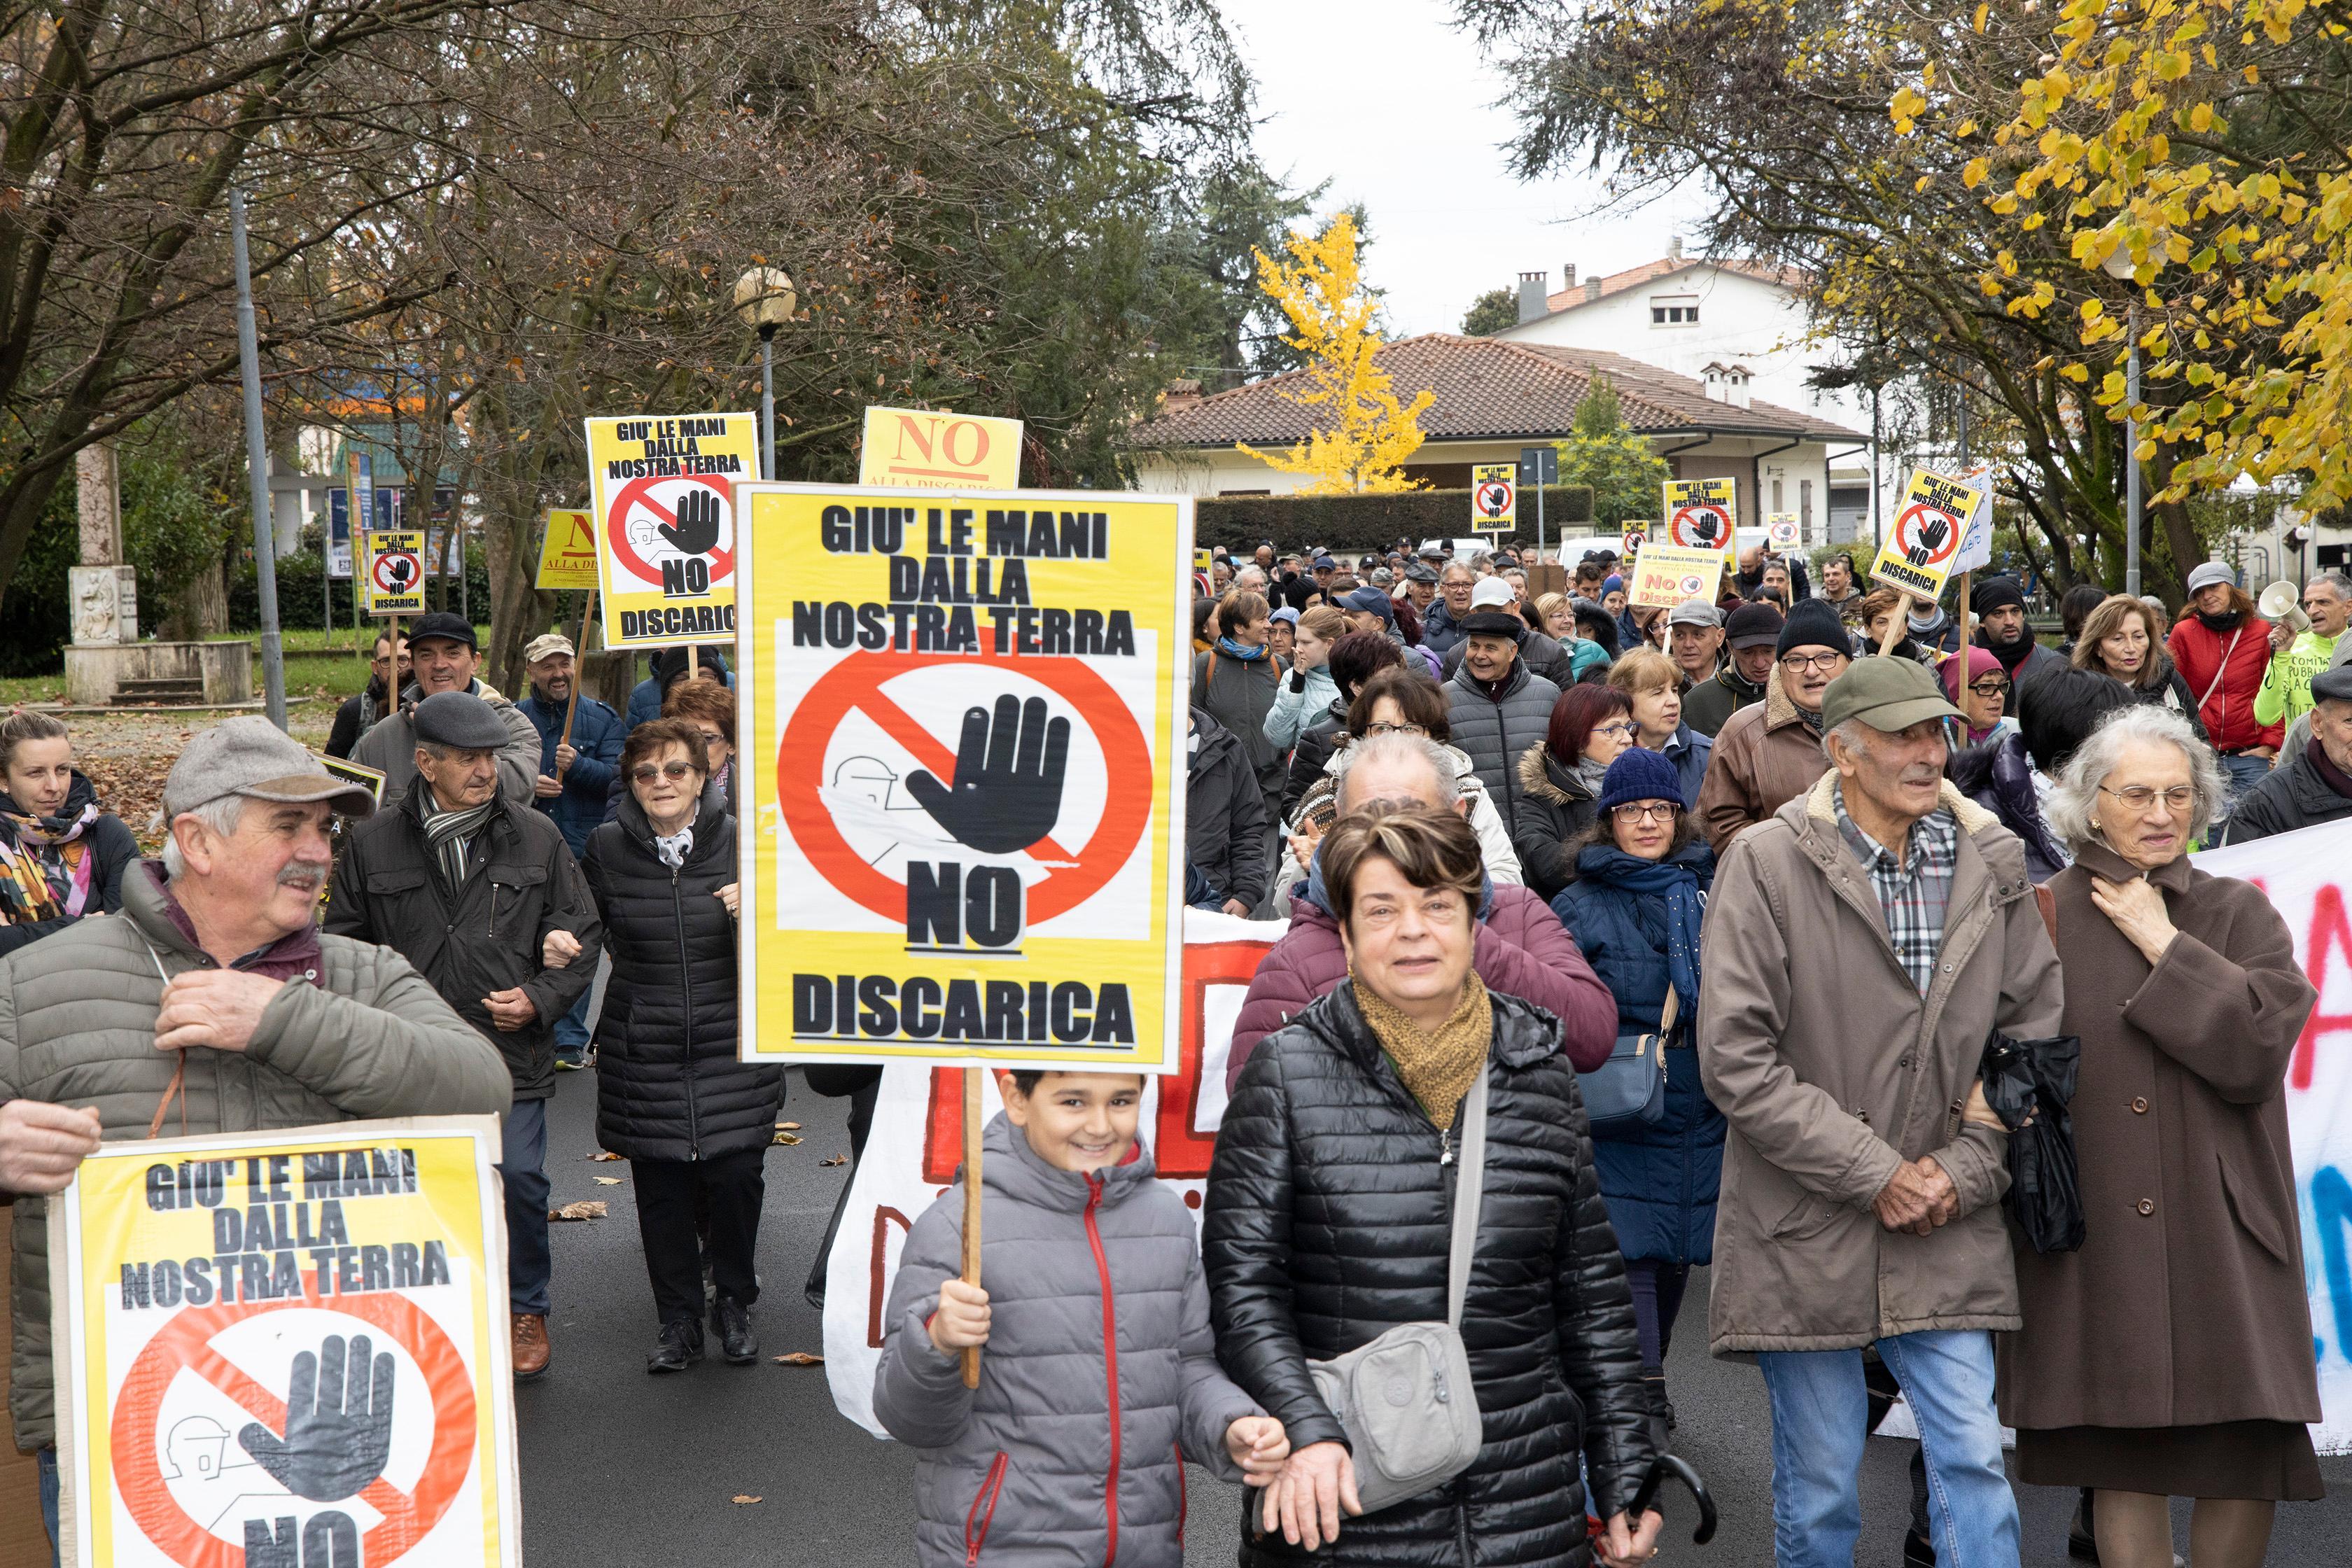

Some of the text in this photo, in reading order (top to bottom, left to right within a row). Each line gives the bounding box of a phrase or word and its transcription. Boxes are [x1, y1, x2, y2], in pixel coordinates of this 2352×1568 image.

[617, 418, 726, 441] GIU' LE MANI
[890, 415, 990, 467] NO
[644, 438, 699, 458] DALLA
[608, 454, 741, 479] NOSTRA TERRA
[1702, 482, 1721, 490] MANI
[1924, 475, 1969, 500] GIU' LE MANI
[1930, 489, 1952, 504] DALLA
[1489, 507, 1499, 517] NO
[1673, 498, 1727, 507] NOSTRA TERRA
[1911, 491, 1966, 519] NOSTRA TERRA
[564, 514, 595, 548] N
[822, 505, 1107, 559] GIU' LE MANI
[546, 559, 578, 568] ALLA
[1906, 545, 1928, 566] NO
[390, 582, 405, 594] NO
[662, 557, 708, 594] NO
[890, 556, 1030, 605] DALLA
[1645, 574, 1675, 590] No
[1880, 560, 1937, 592] DISCARICA
[375, 598, 419, 608] DISCARICA
[620, 605, 734, 636] DISCARIC
[792, 601, 1135, 655] NOSTRA TERRA
[907, 861, 1022, 947] NO
[792, 973, 1135, 1043] DISCARICA
[146, 1149, 415, 1211] GIU' LE MANI
[213, 1200, 349, 1254] DALLA
[121, 1240, 451, 1310] NOSTRA TERRA
